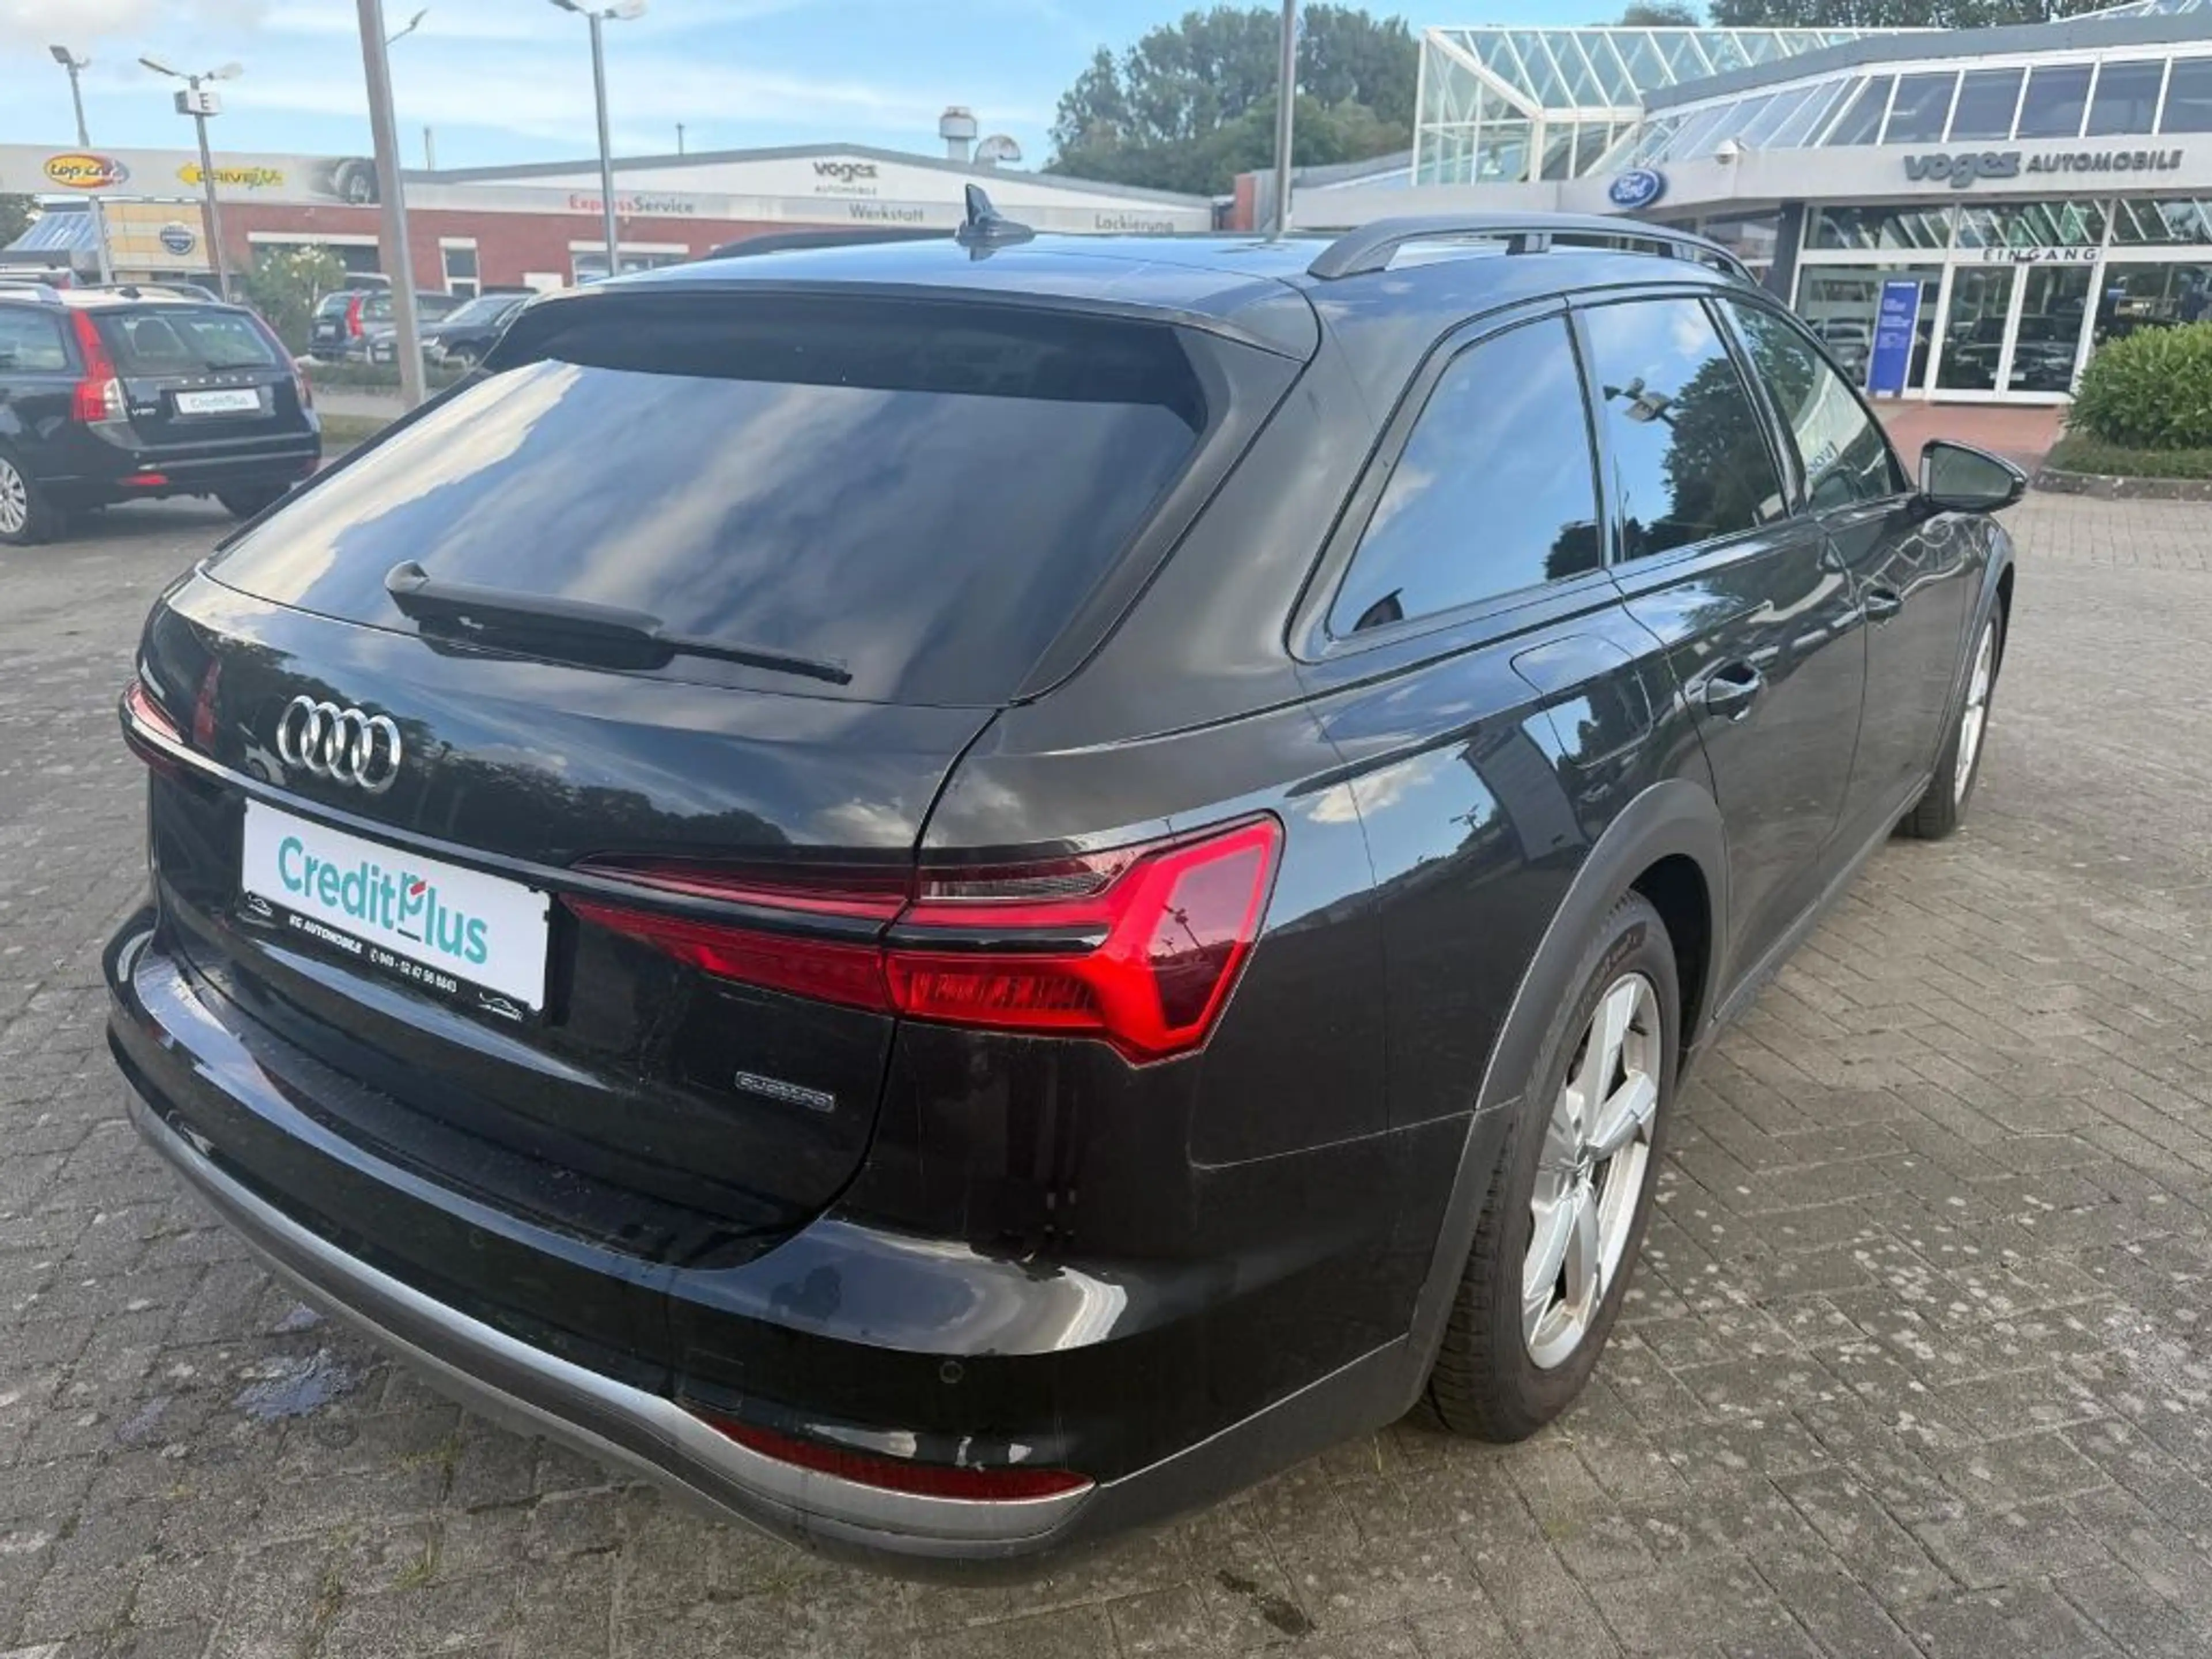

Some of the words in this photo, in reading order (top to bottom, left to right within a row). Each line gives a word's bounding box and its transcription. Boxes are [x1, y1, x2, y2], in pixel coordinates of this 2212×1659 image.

[198, 92, 210, 111] E
[813, 160, 878, 183] voges
[1904, 151, 2021, 188] voges
[2026, 149, 2184, 174] AUTOMOBILE
[848, 202, 924, 222] Werkstatt
[1983, 248, 2097, 261] EINGANG
[278, 835, 488, 965] CreditPlus
